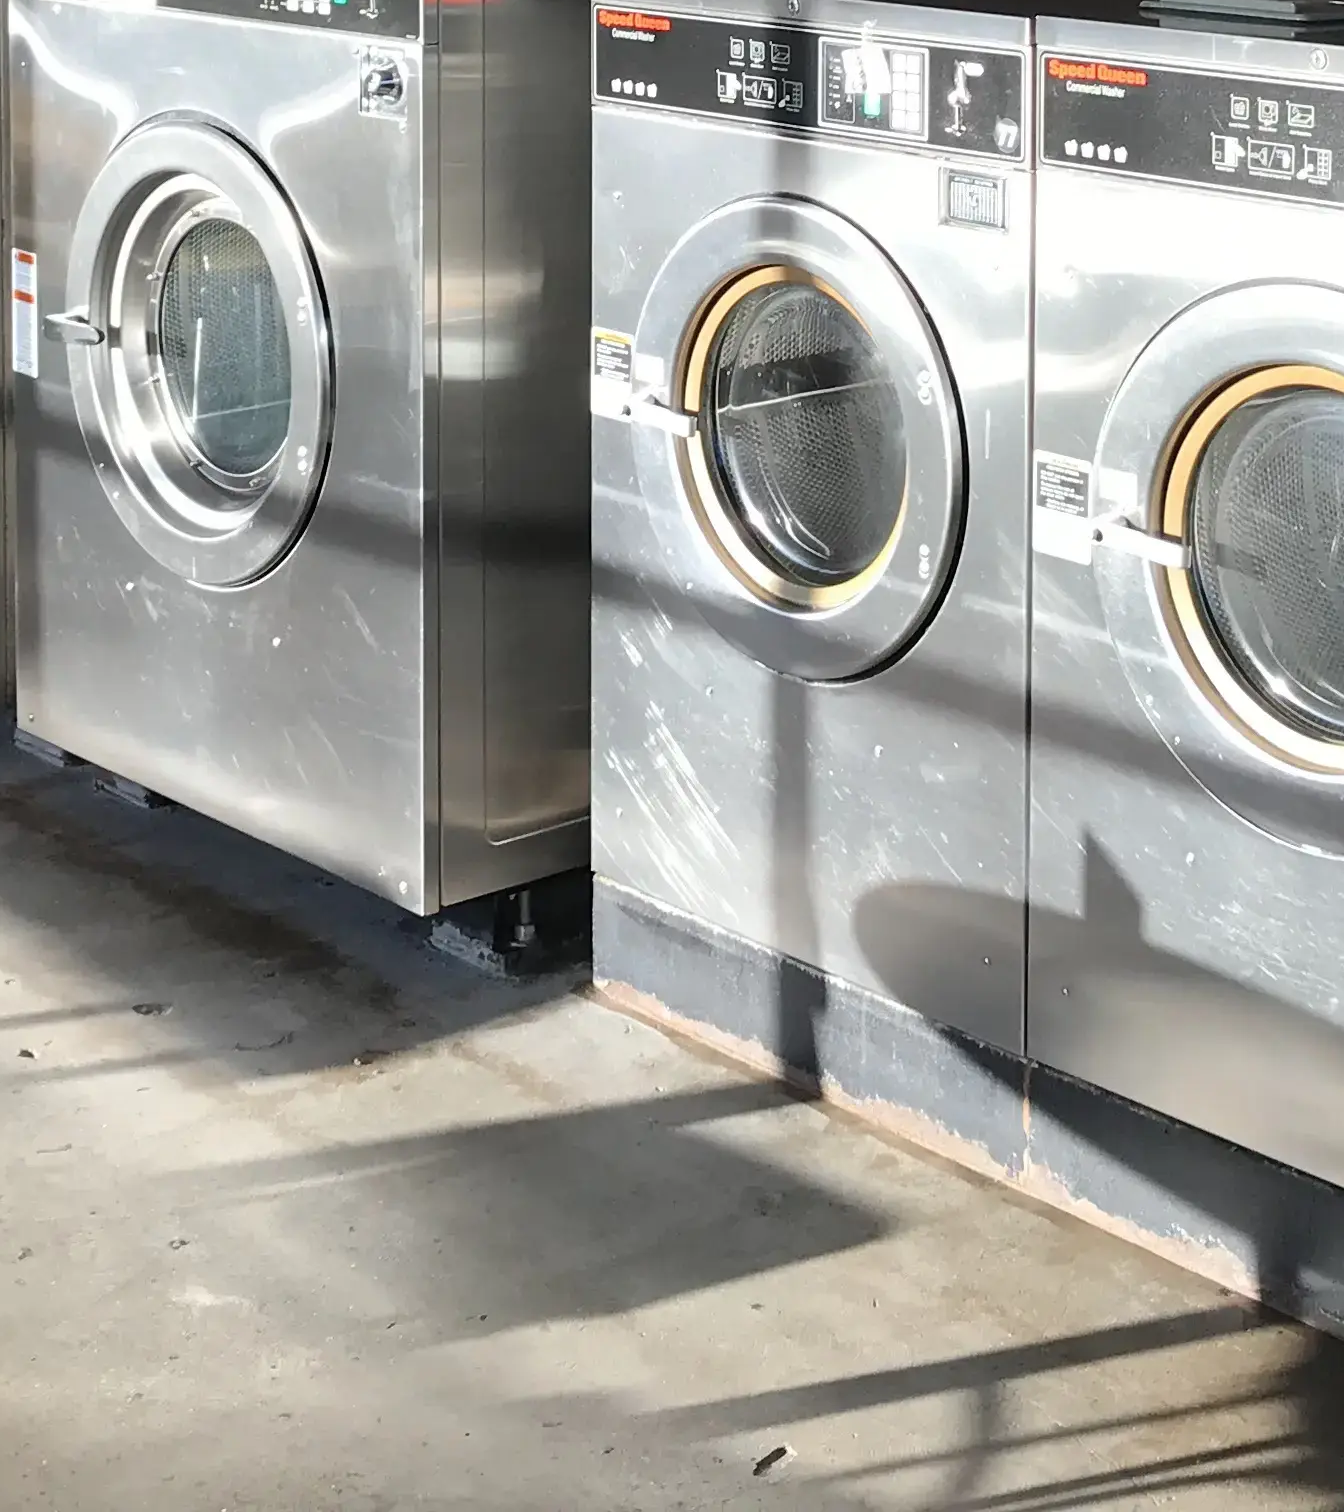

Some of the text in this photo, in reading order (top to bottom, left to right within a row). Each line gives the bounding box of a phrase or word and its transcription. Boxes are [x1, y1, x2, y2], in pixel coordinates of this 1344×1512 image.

[599, 10, 634, 27] Speed
[1049, 59, 1146, 86] Speed Queen
[997, 122, 1018, 148] 77
